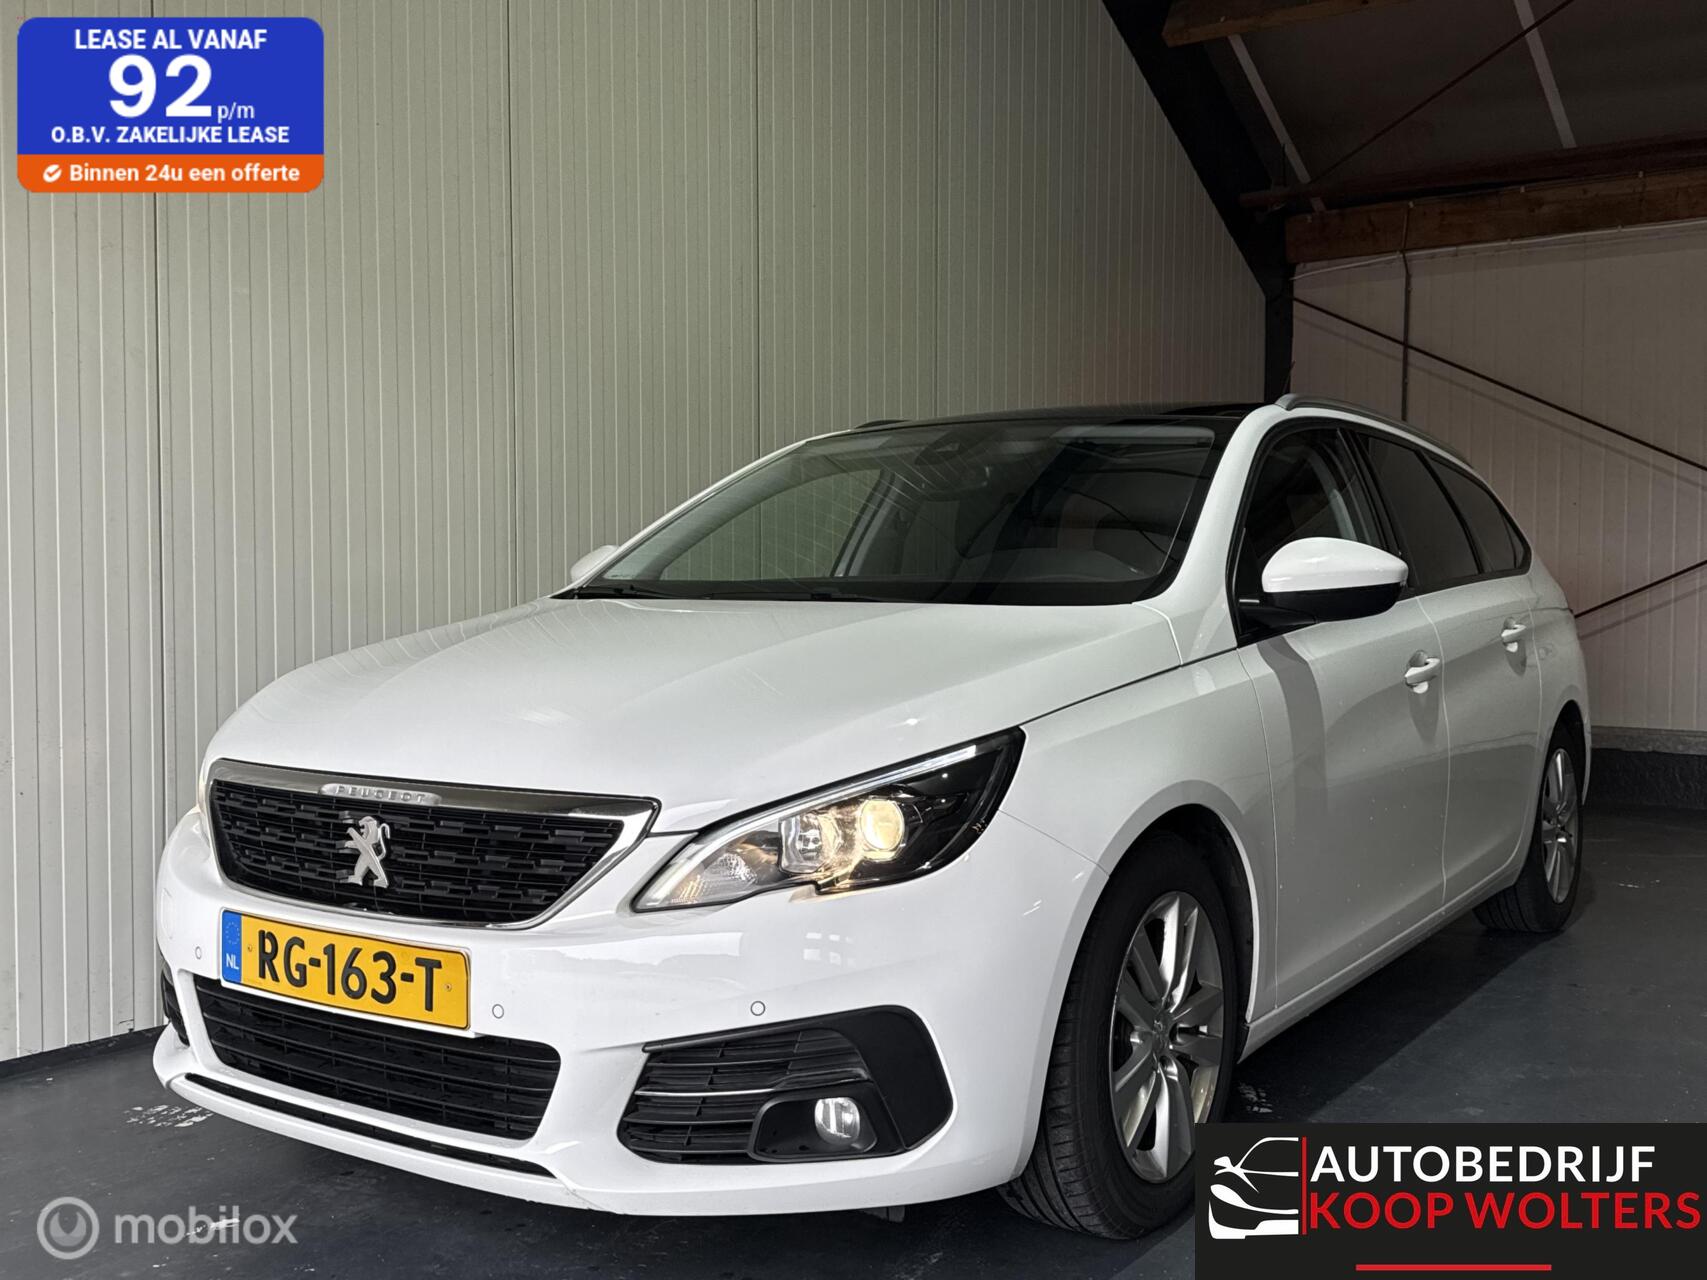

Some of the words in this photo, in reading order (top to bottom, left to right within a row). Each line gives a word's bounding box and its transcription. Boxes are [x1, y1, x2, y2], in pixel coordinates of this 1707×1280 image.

[335, 784, 426, 804] PEUGEOT
[225, 953, 239, 970] NL
[257, 929, 442, 1012] RG-163-T
